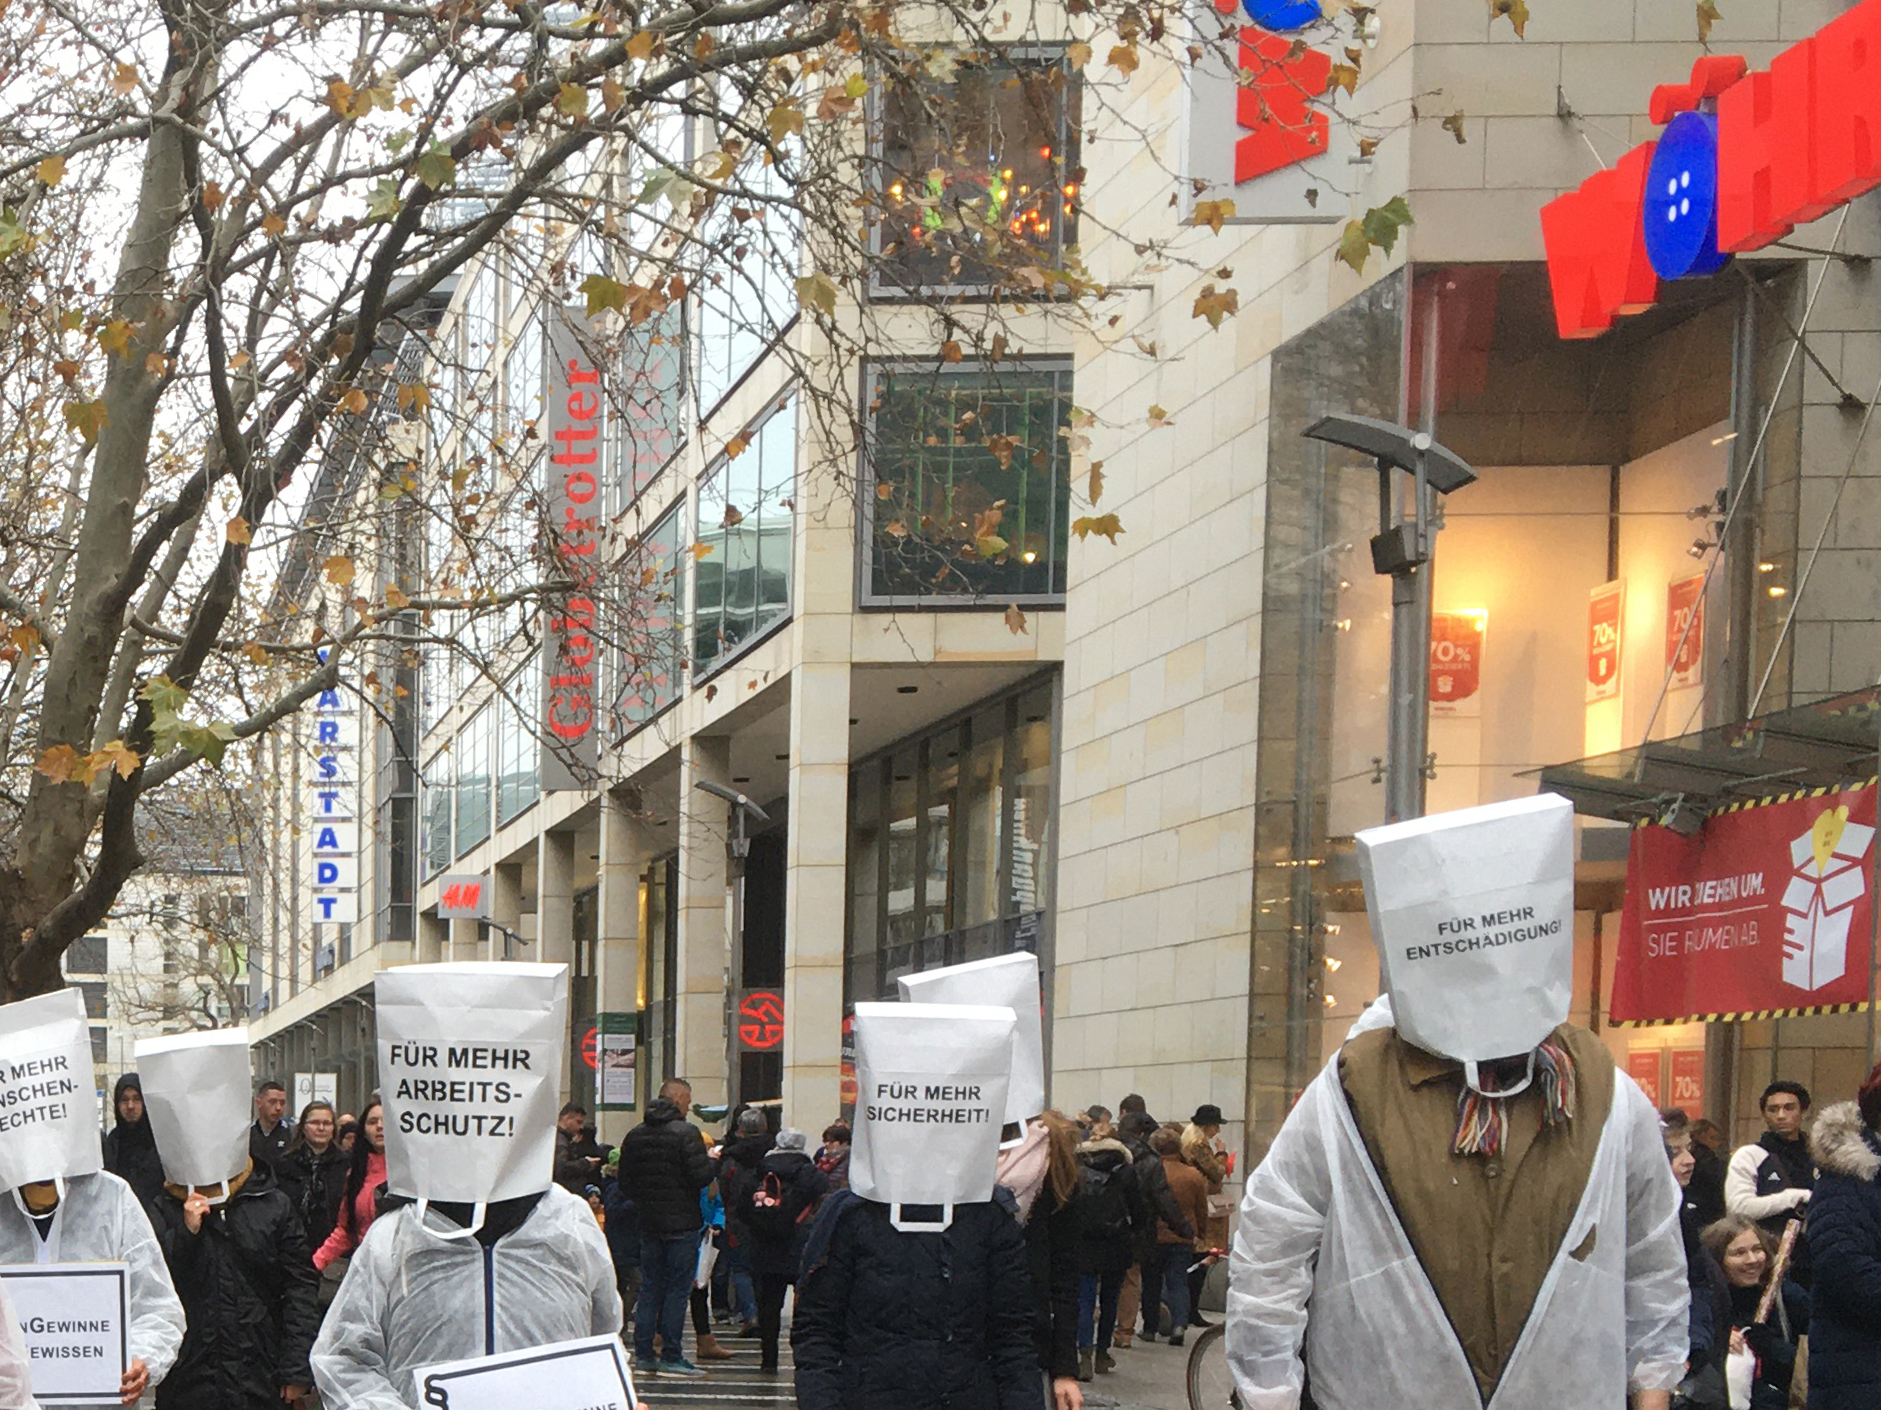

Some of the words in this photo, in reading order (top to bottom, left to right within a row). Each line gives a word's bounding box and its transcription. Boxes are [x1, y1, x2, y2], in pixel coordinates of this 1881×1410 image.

[315, 650, 340, 920] ARSTADT
[1648, 884, 1691, 910] WIR
[1741, 871, 1765, 898] UM.
[1438, 917, 1476, 936] FÜR
[1481, 906, 1534, 928] MEHR
[1406, 919, 1562, 961] ENTSCHÄDIGUNG!
[1648, 931, 1679, 958] SIE
[10, 1055, 69, 1080] MEHR
[390, 1041, 438, 1067] FÜR
[448, 1047, 531, 1070] MEHR
[396, 1078, 522, 1103] ARBEITS-
[877, 1081, 918, 1100] FÜR
[924, 1085, 981, 1101] MEHR
[400, 1111, 514, 1137] SCHUTZ!
[866, 1106, 989, 1123] SICHERHEIT!
[30, 1345, 104, 1359] EWISSEN
